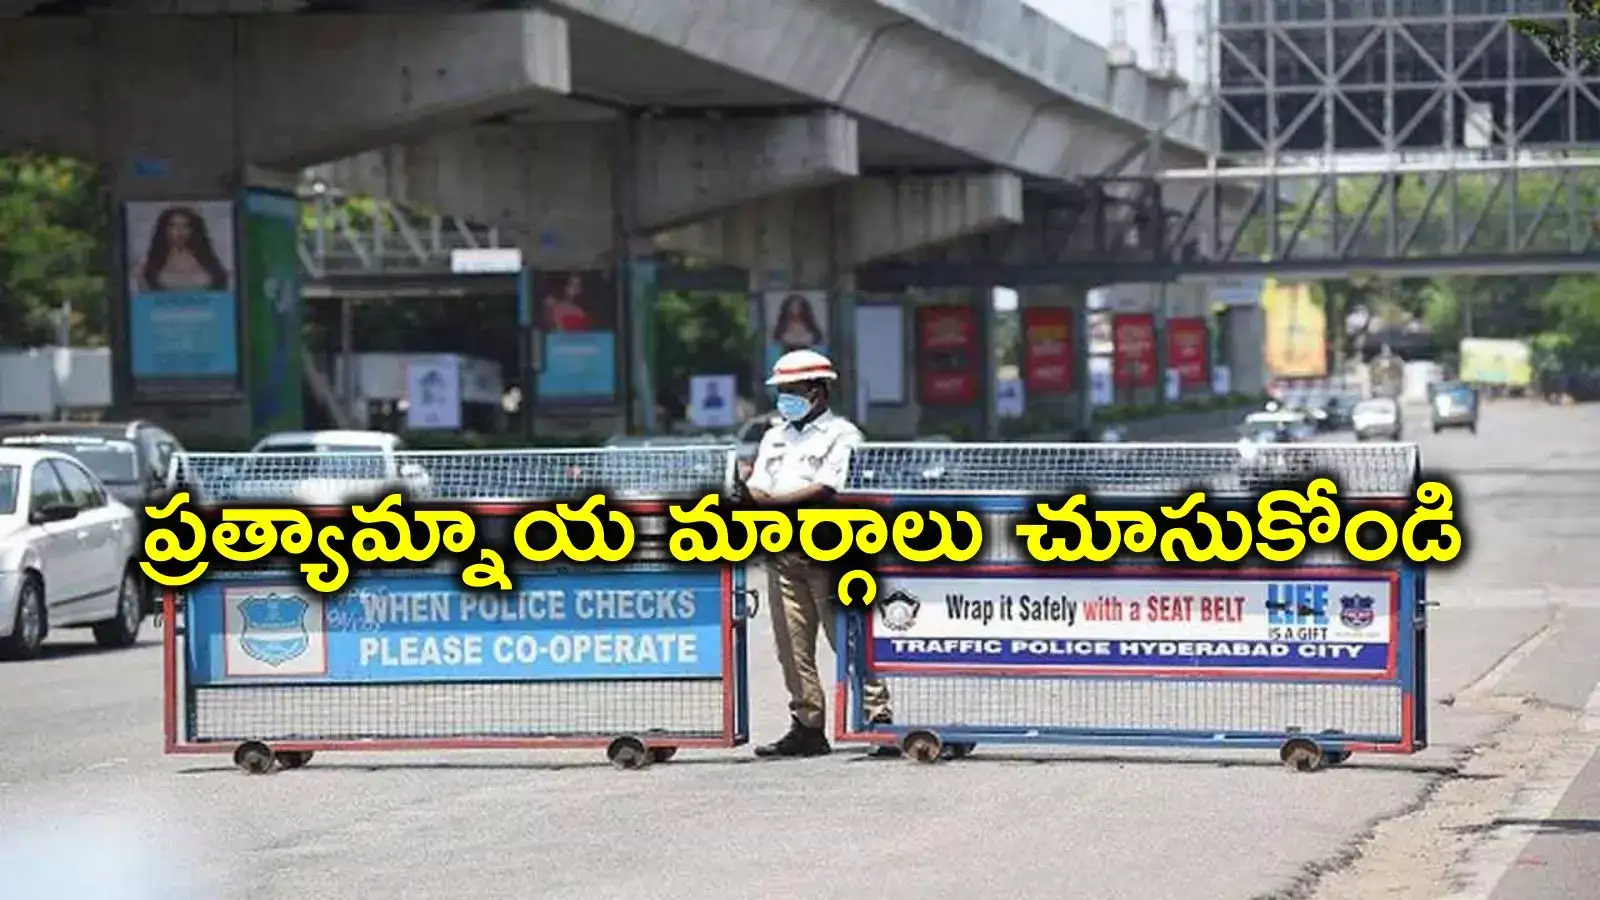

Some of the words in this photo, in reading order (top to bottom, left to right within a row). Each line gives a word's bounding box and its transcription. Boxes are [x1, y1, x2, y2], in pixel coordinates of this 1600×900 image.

[361, 591, 450, 623] WHEN
[460, 590, 567, 622] POLICE
[574, 589, 696, 620] CHECKS
[945, 594, 994, 626] Wrap
[1000, 594, 1013, 621] it
[1019, 594, 1078, 627] Safely
[1083, 595, 1123, 621] with
[1130, 600, 1141, 621] a
[1147, 595, 1193, 622] SEAT
[1201, 596, 1246, 622] BELT
[359, 636, 483, 667] PLEASE
[492, 633, 698, 664] CO-OPERATE
[891, 639, 1002, 654] TRAFFIC
[1011, 640, 1111, 656] POLICE
[1121, 641, 1291, 658] HYDERABAD
[1298, 643, 1364, 659] CITY
[1284, 626, 1294, 640] A
[1297, 627, 1329, 641] GIFT
